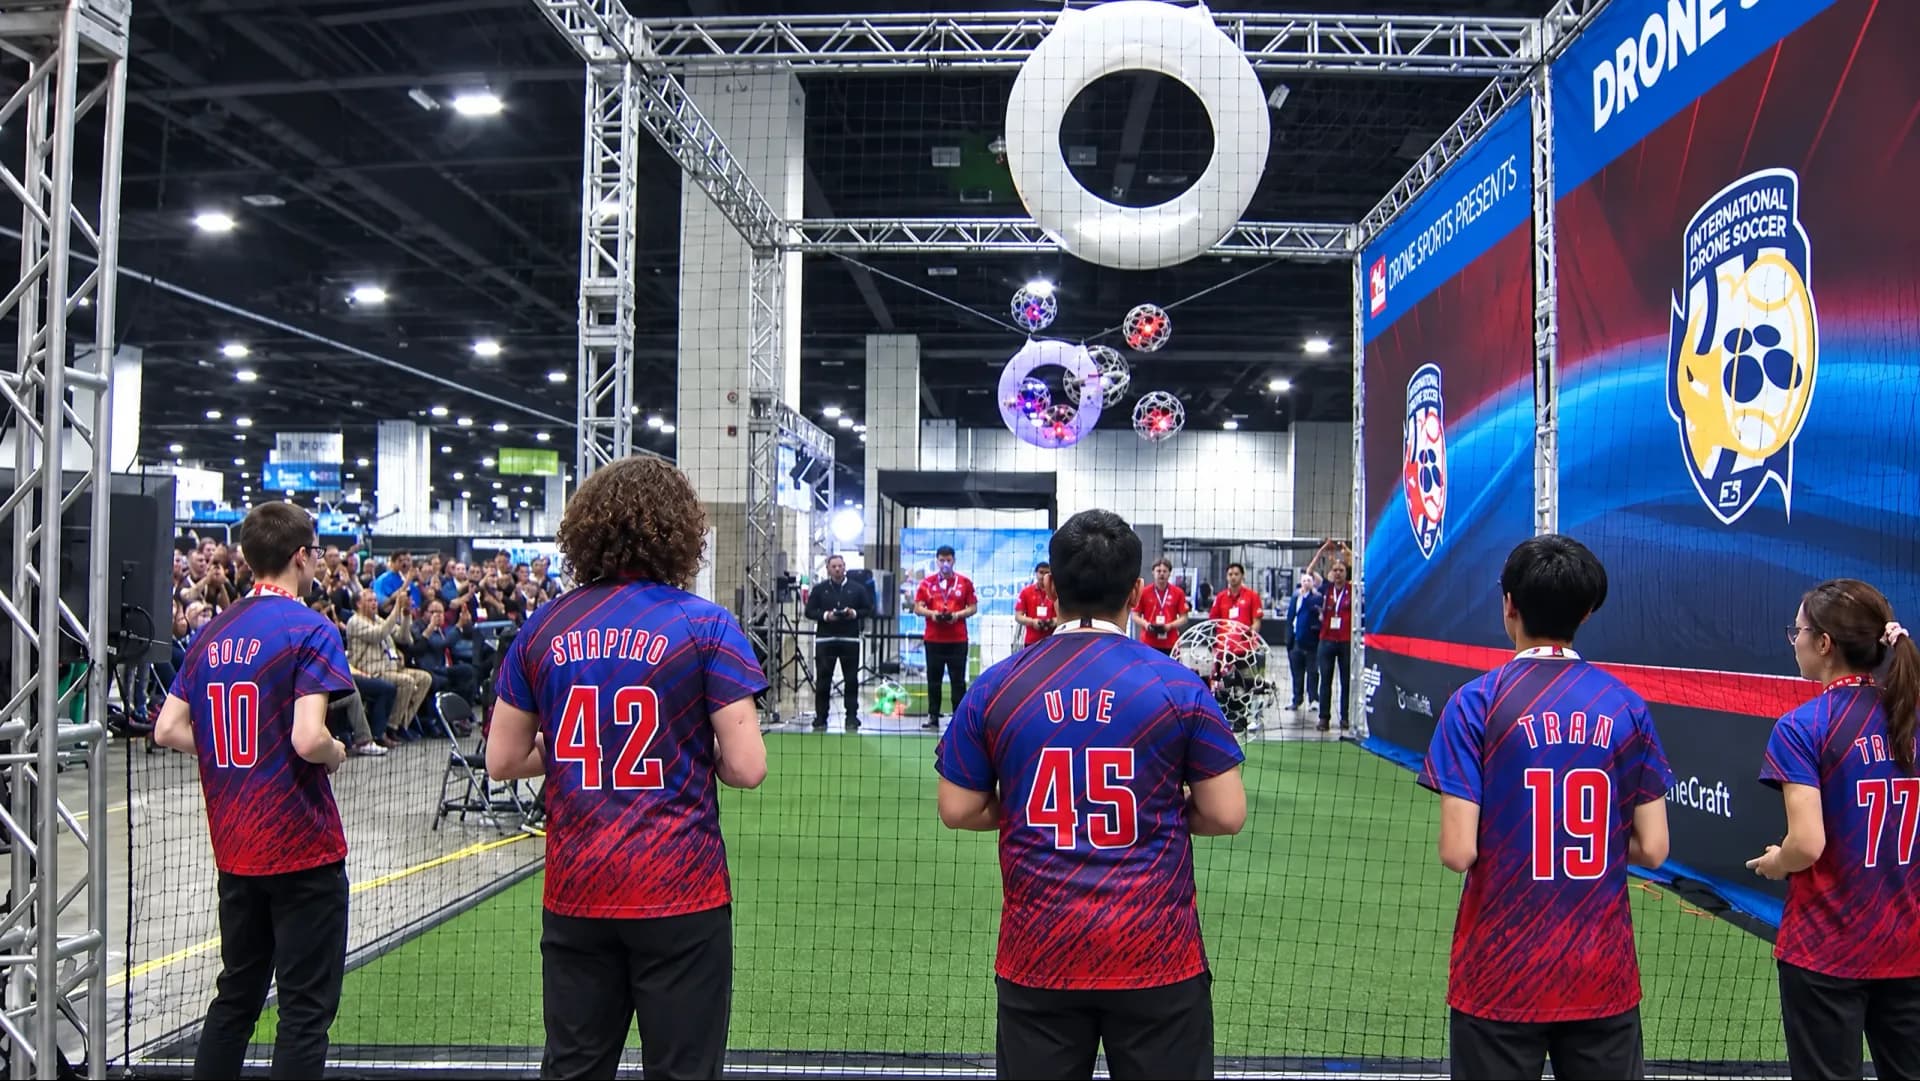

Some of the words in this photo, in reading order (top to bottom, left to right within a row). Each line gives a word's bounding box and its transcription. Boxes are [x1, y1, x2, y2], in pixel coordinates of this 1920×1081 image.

[1593, 0, 1726, 133] DRONE
[1388, 241, 1416, 292] DRONE
[1417, 209, 1453, 265] SPORTS
[1456, 154, 1517, 235] PRESENTS
[1690, 187, 1788, 256] INTERNATIONAL
[1690, 228, 1731, 280] DRONE
[1732, 215, 1786, 247] SOCCER
[207, 638, 261, 668] GOLP
[552, 628, 669, 666] SHAPIRO
[207, 681, 259, 768] 10
[555, 685, 665, 790] 42
[1518, 711, 1613, 749] TRAN
[1026, 747, 1138, 849] 45
[1524, 768, 1611, 880] 19
[1857, 778, 1920, 867] 77
